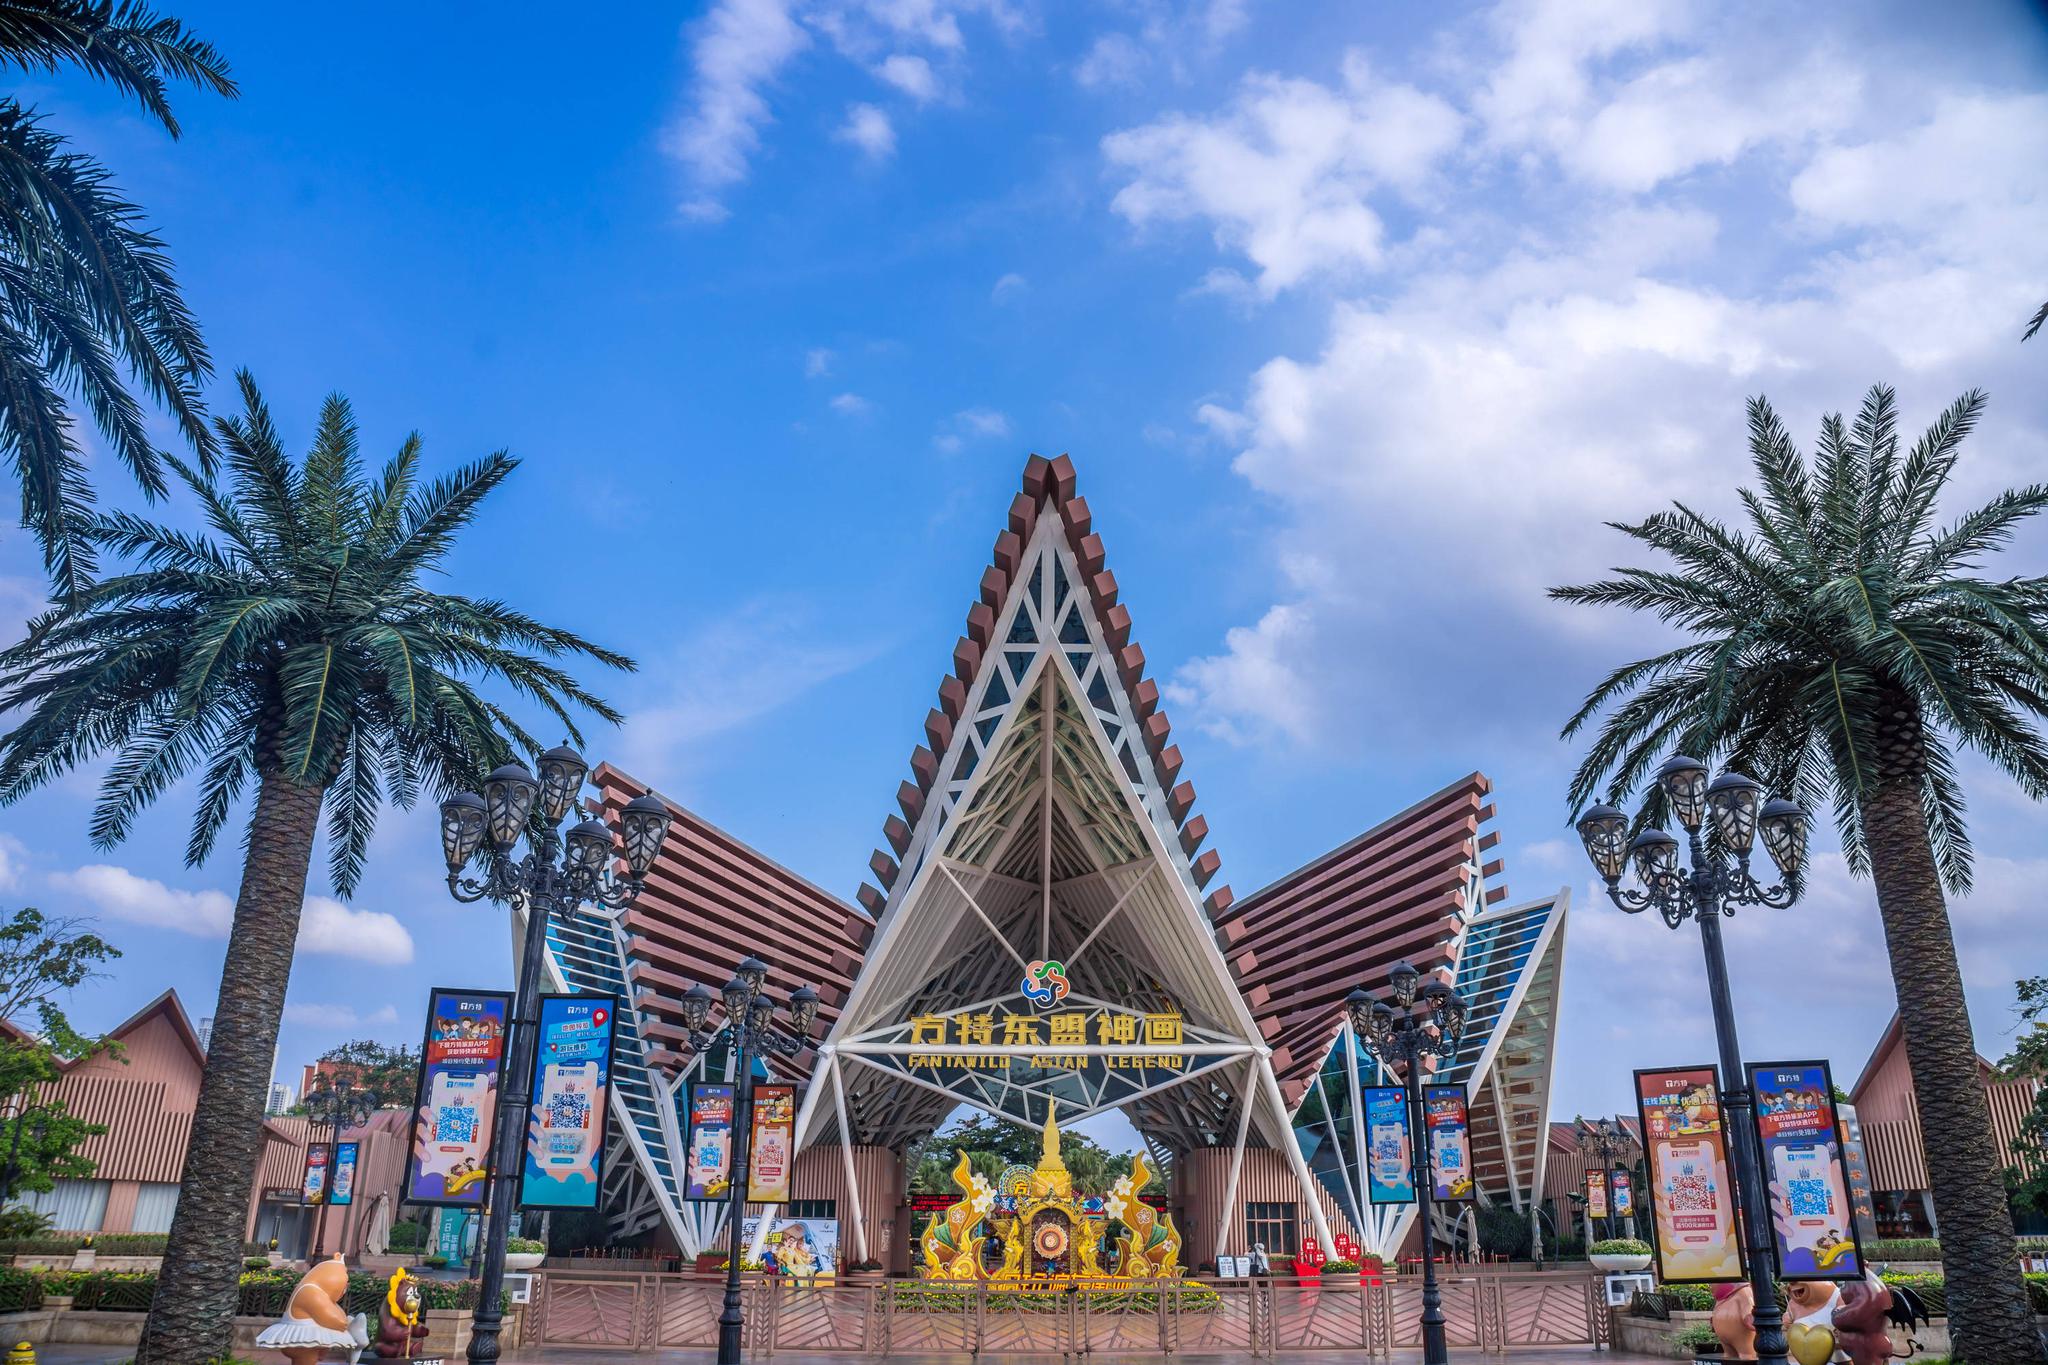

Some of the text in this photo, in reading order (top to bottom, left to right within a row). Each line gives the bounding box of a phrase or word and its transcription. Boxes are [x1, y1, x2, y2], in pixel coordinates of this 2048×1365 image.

[910, 1012, 1184, 1045] 方特东盟神画
[909, 1054, 1183, 1069] FANTAWILD ASIAN LEGEND
